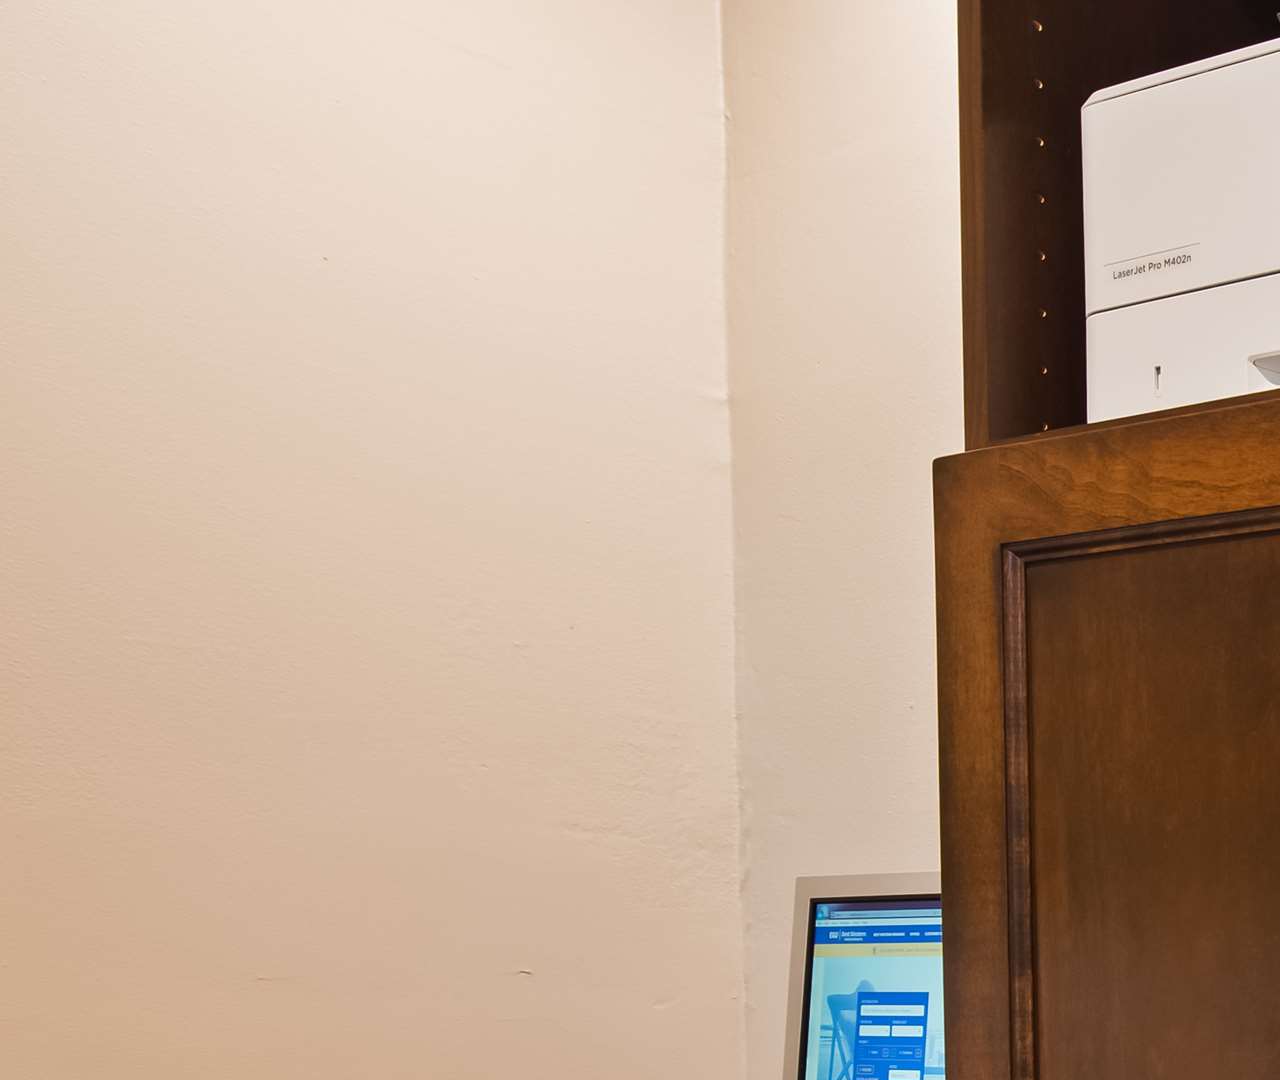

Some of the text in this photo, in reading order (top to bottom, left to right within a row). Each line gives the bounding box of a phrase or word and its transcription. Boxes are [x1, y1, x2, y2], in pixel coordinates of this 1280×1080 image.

[1113, 254, 1192, 280] LaserJet Pro M402n
